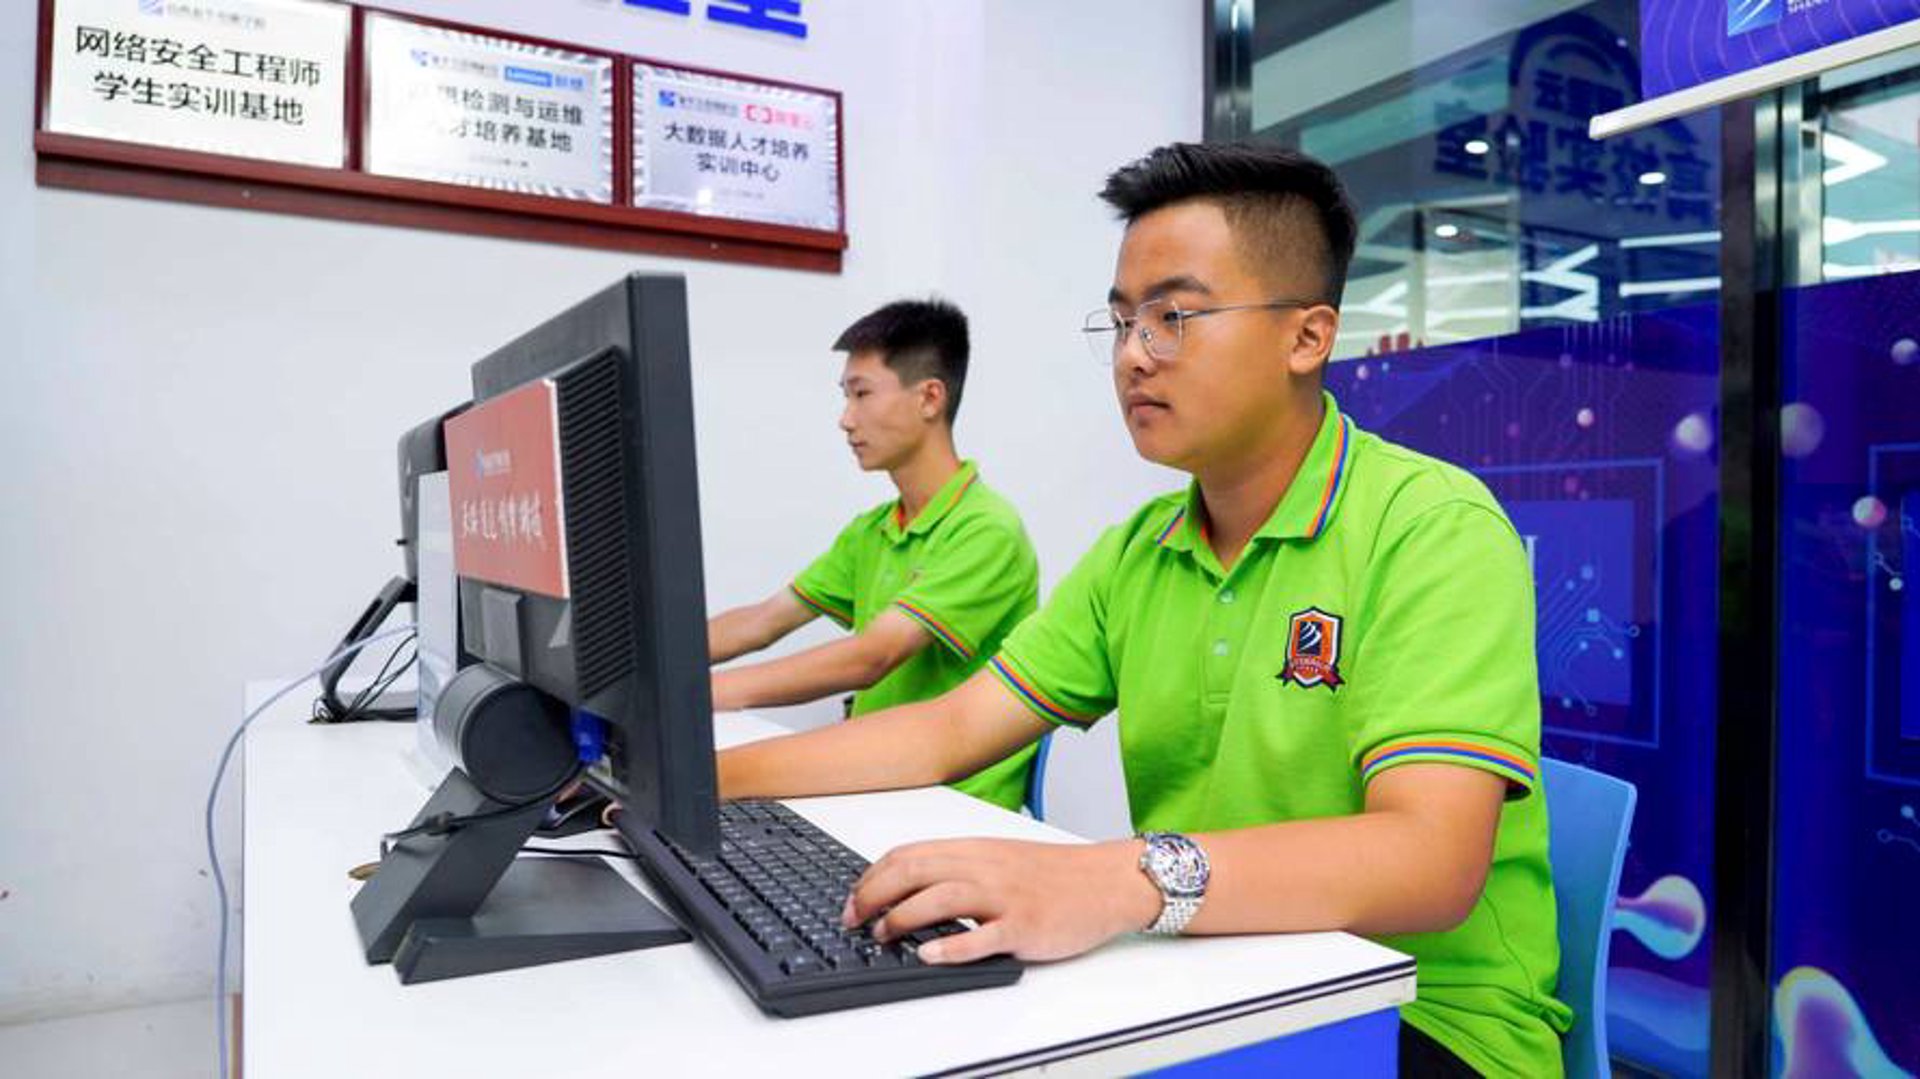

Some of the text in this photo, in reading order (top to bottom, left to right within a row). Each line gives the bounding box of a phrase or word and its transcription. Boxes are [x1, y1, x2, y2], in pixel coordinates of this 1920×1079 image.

[75, 25, 322, 88] 网络安全工程师
[94, 71, 304, 126] 学生实训基地
[428, 119, 573, 152] 才培养基地
[663, 122, 810, 161] 大数据人才培养
[697, 152, 780, 182] 实训中心
